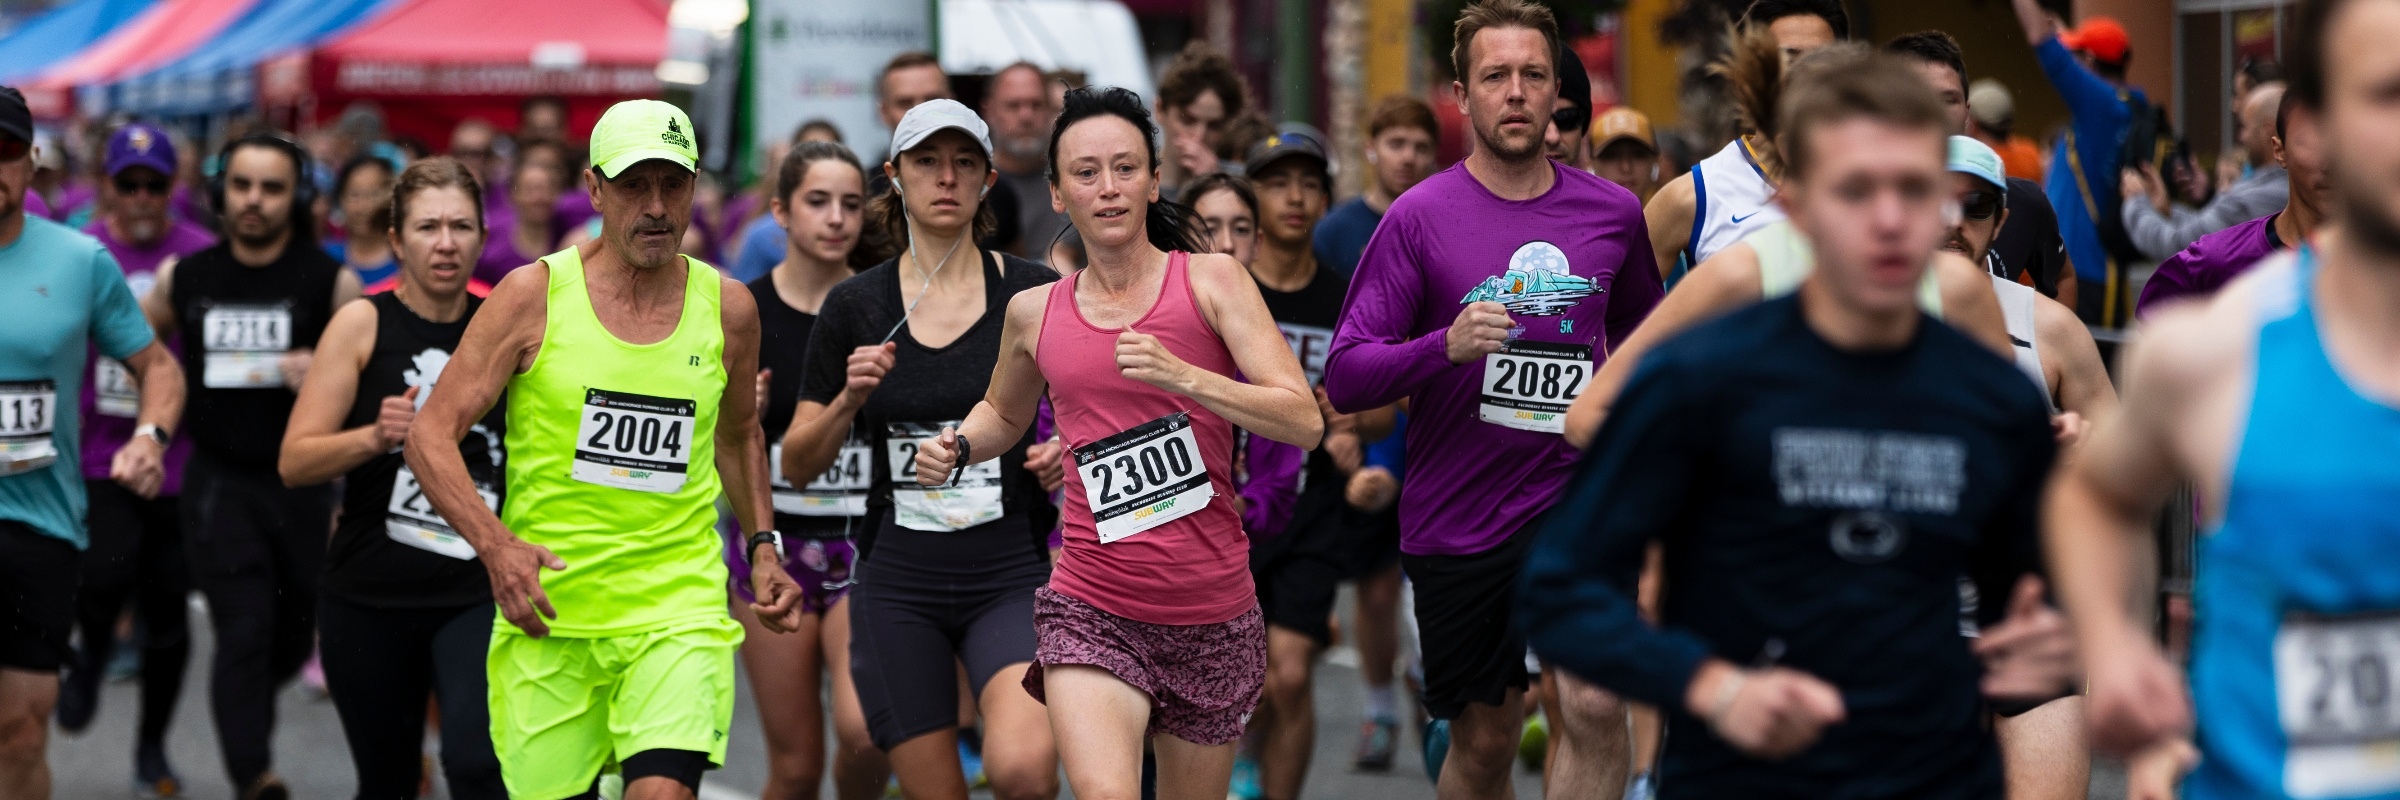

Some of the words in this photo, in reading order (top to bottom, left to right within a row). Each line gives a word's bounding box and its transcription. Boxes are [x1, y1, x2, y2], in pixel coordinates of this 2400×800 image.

[662, 133, 690, 147] CHICAGO
[1560, 320, 1573, 333] 5K
[1493, 359, 1583, 400] 2082
[1515, 411, 1555, 421] SUBWAY
[588, 412, 682, 458] 2004
[1105, 441, 1130, 453] ANCHORAGE
[610, 468, 653, 479] SUBWAY
[1092, 437, 1192, 505] 2300
[1134, 498, 1177, 520] SUBWAY
